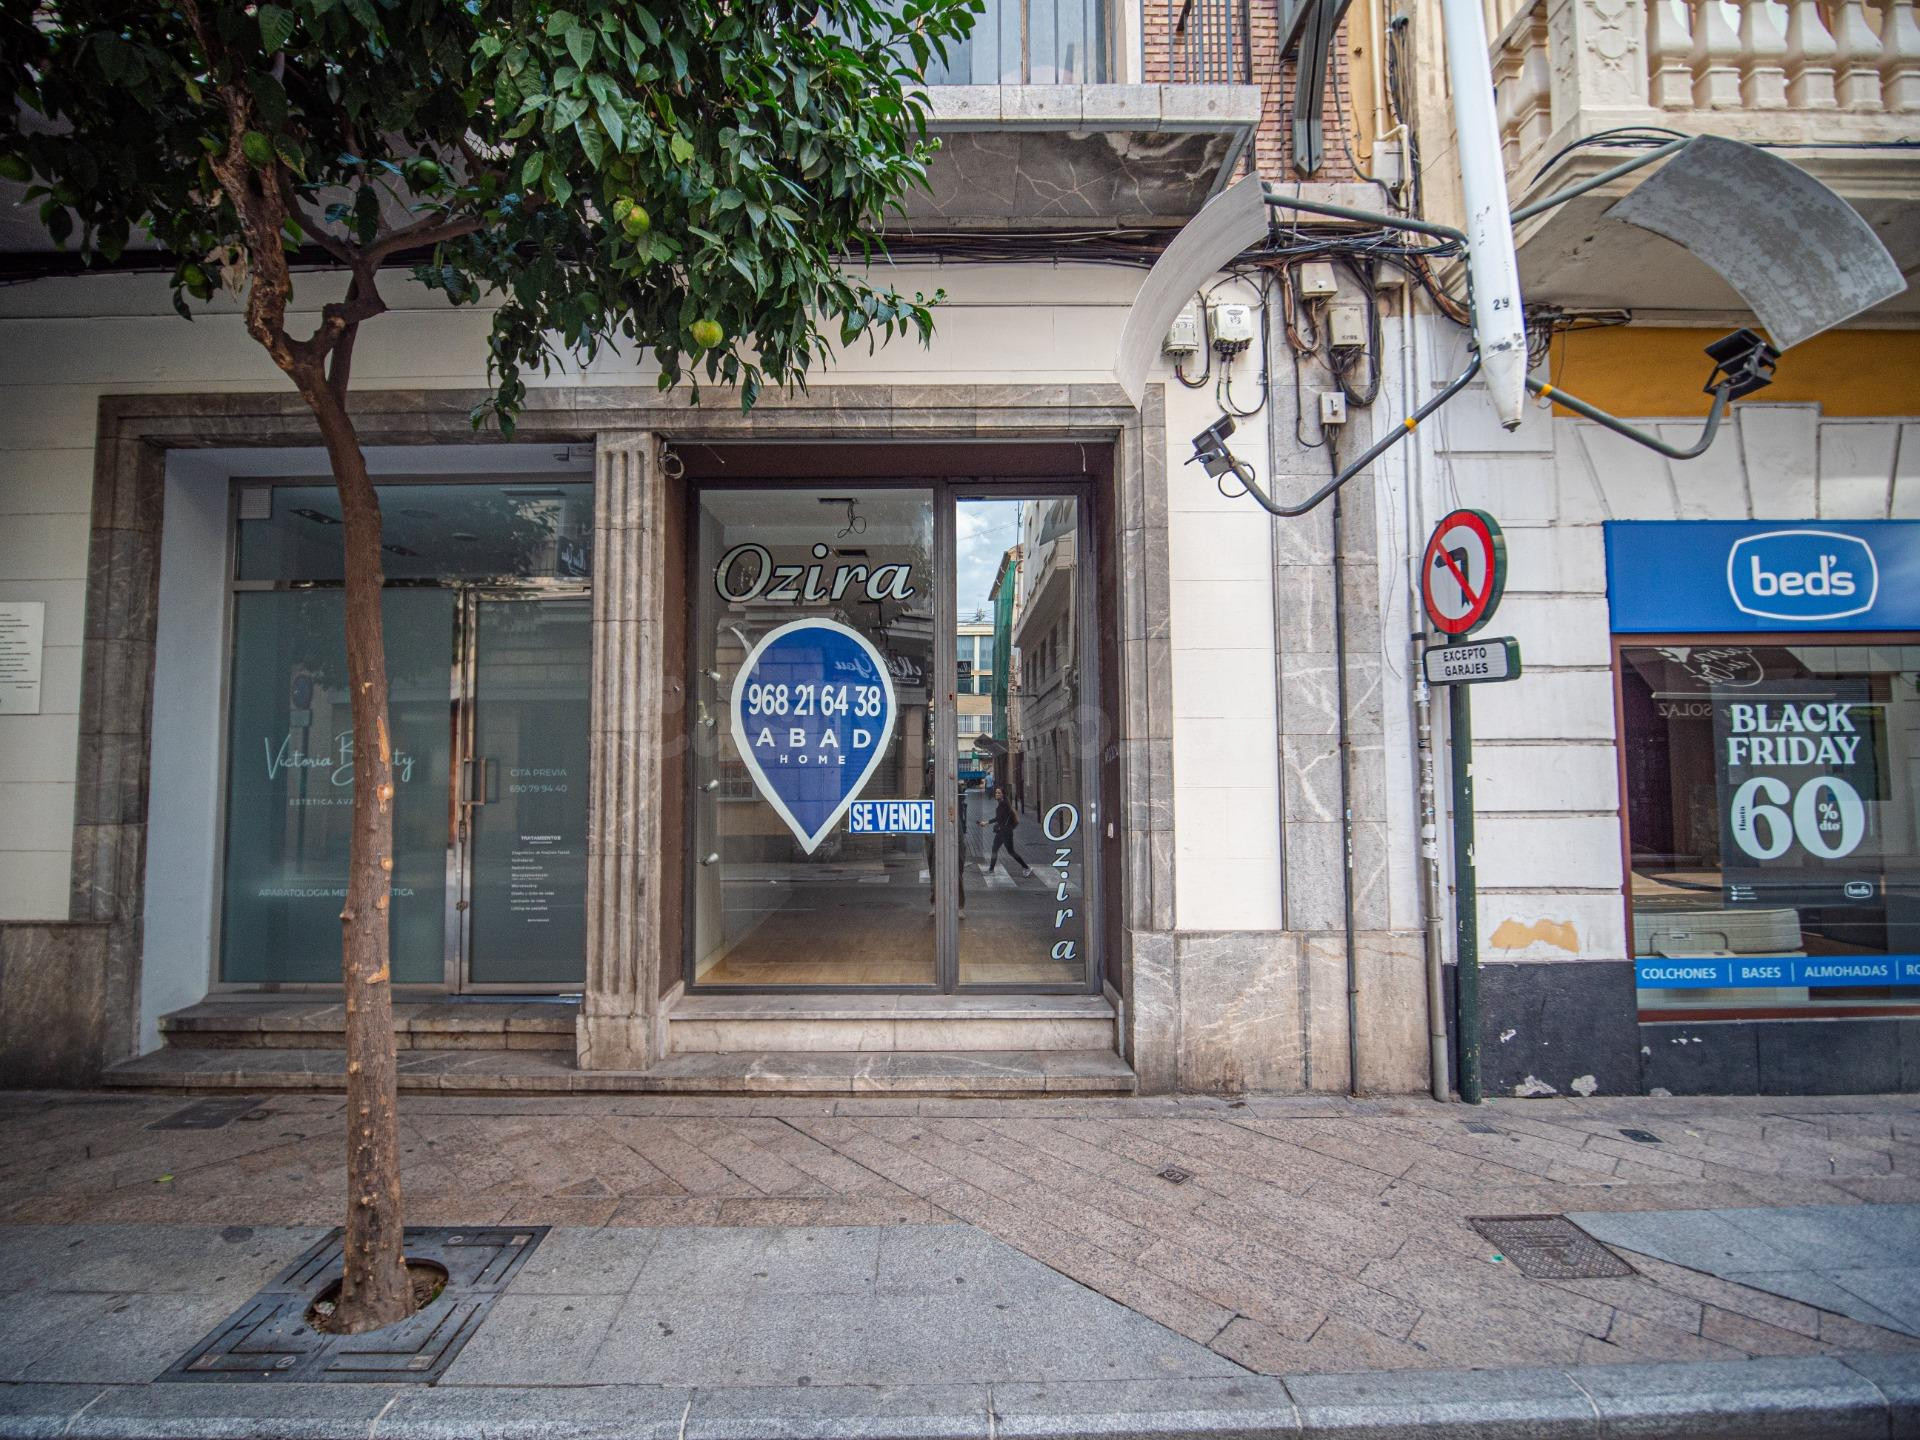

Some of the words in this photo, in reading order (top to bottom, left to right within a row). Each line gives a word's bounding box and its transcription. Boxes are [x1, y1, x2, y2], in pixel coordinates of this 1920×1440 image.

[714, 542, 916, 604] Ozira
[1751, 554, 1856, 597] bed's
[1443, 647, 1487, 662] EXCEPTO
[1445, 662, 1489, 677] GARAJES
[748, 683, 789, 716] 968
[793, 684, 815, 716] 21
[821, 685, 849, 717] 64
[854, 686, 881, 717] 38
[1729, 703, 1856, 733] BLACK
[755, 727, 872, 749] ABAD
[1727, 736, 1861, 766] FRIDAY
[264, 733, 336, 781] Victoria
[779, 754, 846, 765] HOME
[510, 768, 531, 777] CITA
[533, 768, 567, 777] PREVIA
[852, 803, 873, 831] SE
[875, 803, 932, 831] VENDE
[1730, 776, 1865, 860] 60
[1042, 802, 1080, 961] Ozira
[1641, 967, 1718, 980] COLCHONES
[1741, 966, 1782, 979] BASES
[1804, 964, 1889, 978] ALMOHADAS
